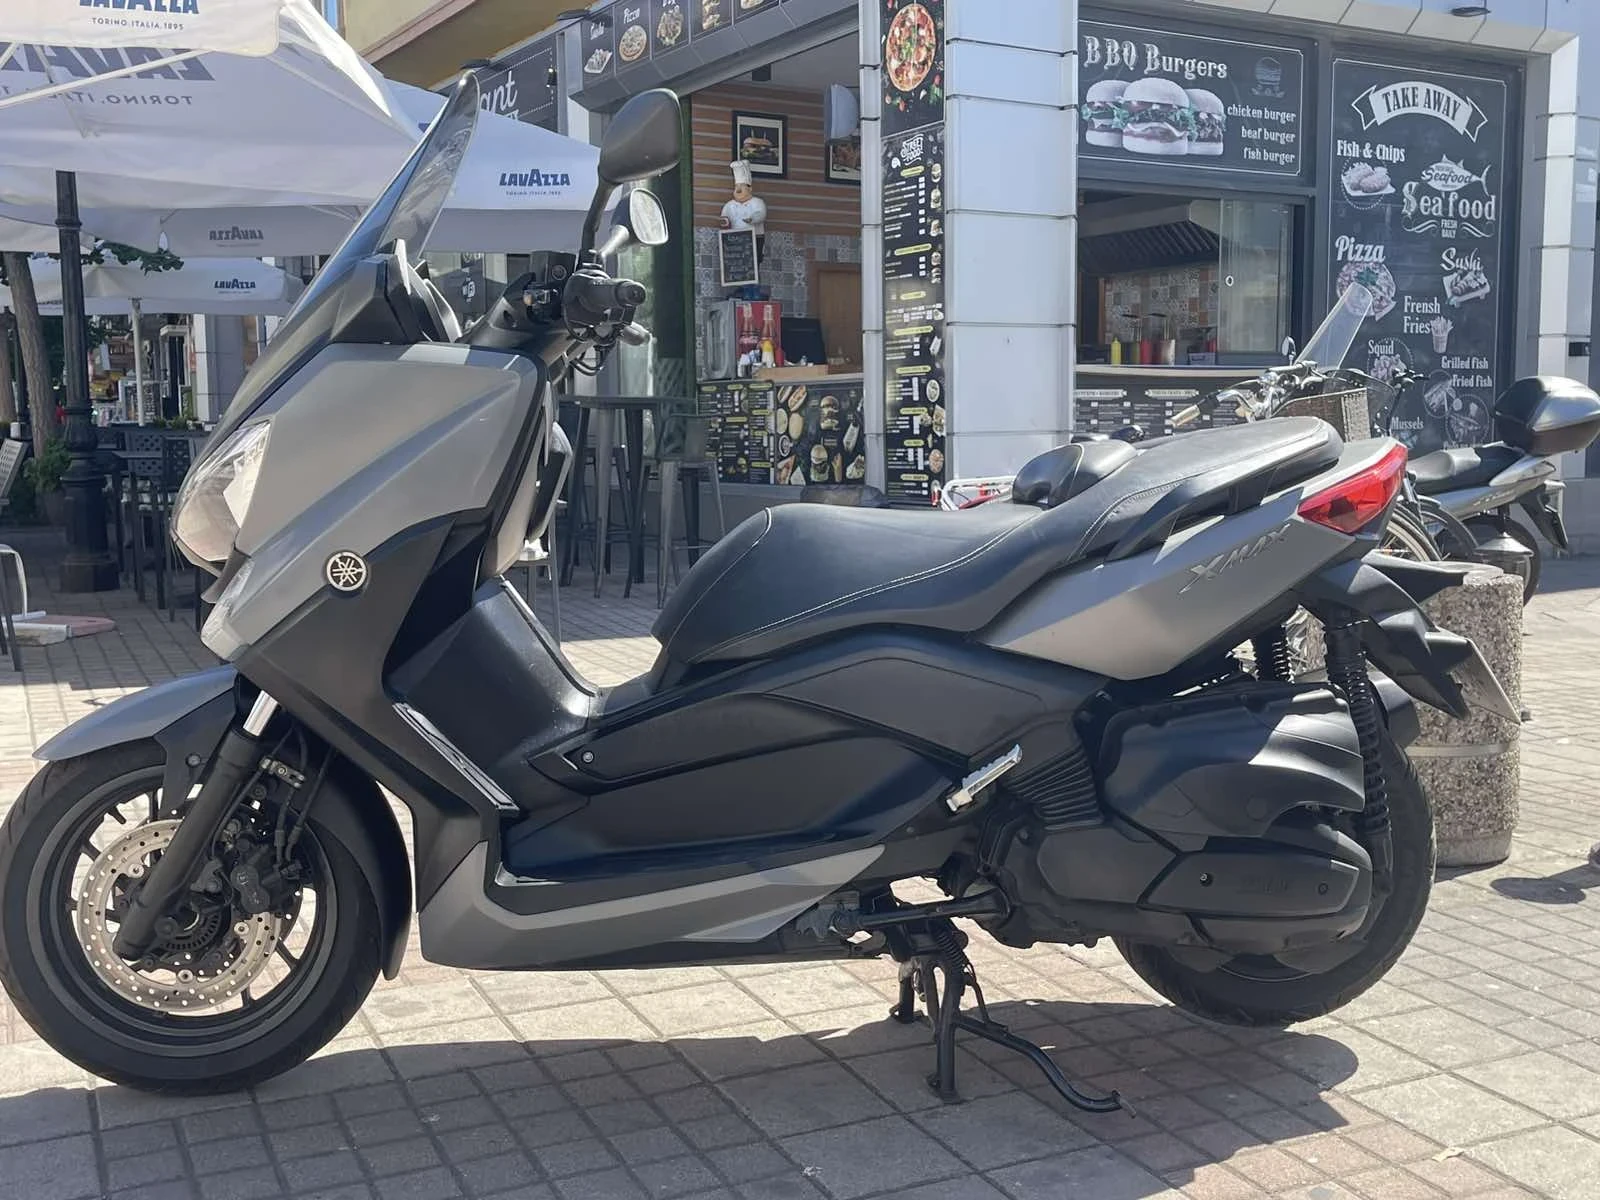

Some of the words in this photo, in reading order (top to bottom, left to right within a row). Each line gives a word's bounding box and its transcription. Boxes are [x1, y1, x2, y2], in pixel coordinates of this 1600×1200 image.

[92, 17, 127, 26] TORINO
[1082, 35, 1137, 71] BBQ
[1143, 43, 1227, 80] Burgers
[1382, 86, 1419, 113] TAKE
[1423, 87, 1462, 121] AWAY
[1227, 103, 1262, 119] chicken
[1264, 107, 1296, 124] burger
[1263, 128, 1296, 145] burger
[1243, 146, 1262, 161] fish
[1263, 149, 1296, 166] burger
[1336, 139, 1360, 159] Fish
[1363, 142, 1372, 158] &
[1376, 143, 1406, 164] Chips
[499, 168, 571, 187] LAVAZZA
[1420, 168, 1473, 185] Seafood
[1334, 235, 1386, 263] Pizza
[1439, 247, 1483, 272] Sushi
[214, 278, 257, 290] LAVAZZA
[1403, 296, 1441, 314] Frensh
[1403, 316, 1431, 335] Fries
[1367, 340, 1395, 355] Squid
[1441, 355, 1470, 370] Grilled
[1471, 356, 1489, 370] fish
[1451, 373, 1474, 388] Fried
[1475, 374, 1493, 388] fish
[1390, 416, 1424, 431] Mussels
